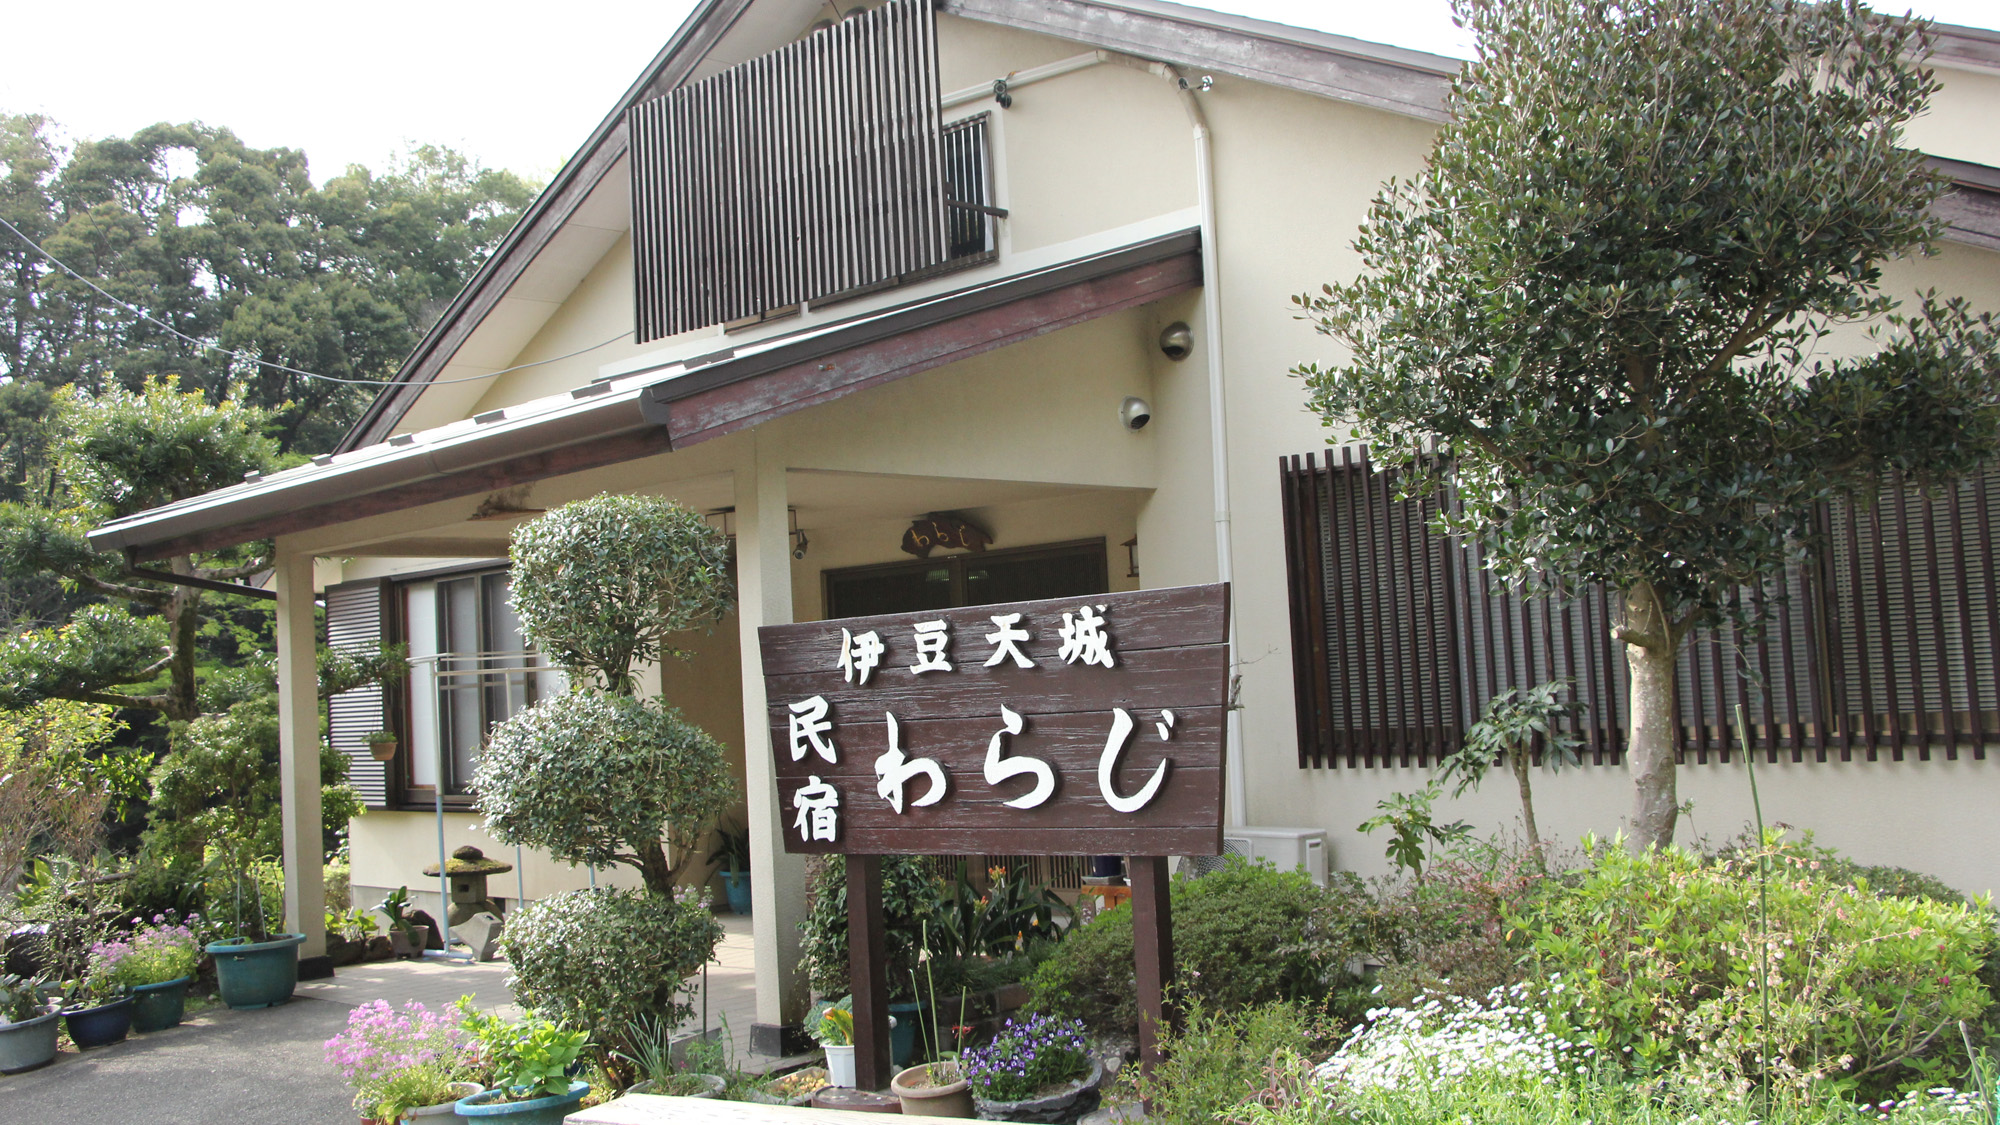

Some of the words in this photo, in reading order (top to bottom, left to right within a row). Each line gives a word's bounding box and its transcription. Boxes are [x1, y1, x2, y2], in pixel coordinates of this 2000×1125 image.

[910, 521, 970, 547] わらじ
[837, 604, 1116, 686] 伊豆天城
[787, 695, 840, 843] 民宿
[874, 703, 1176, 814] わらじ
